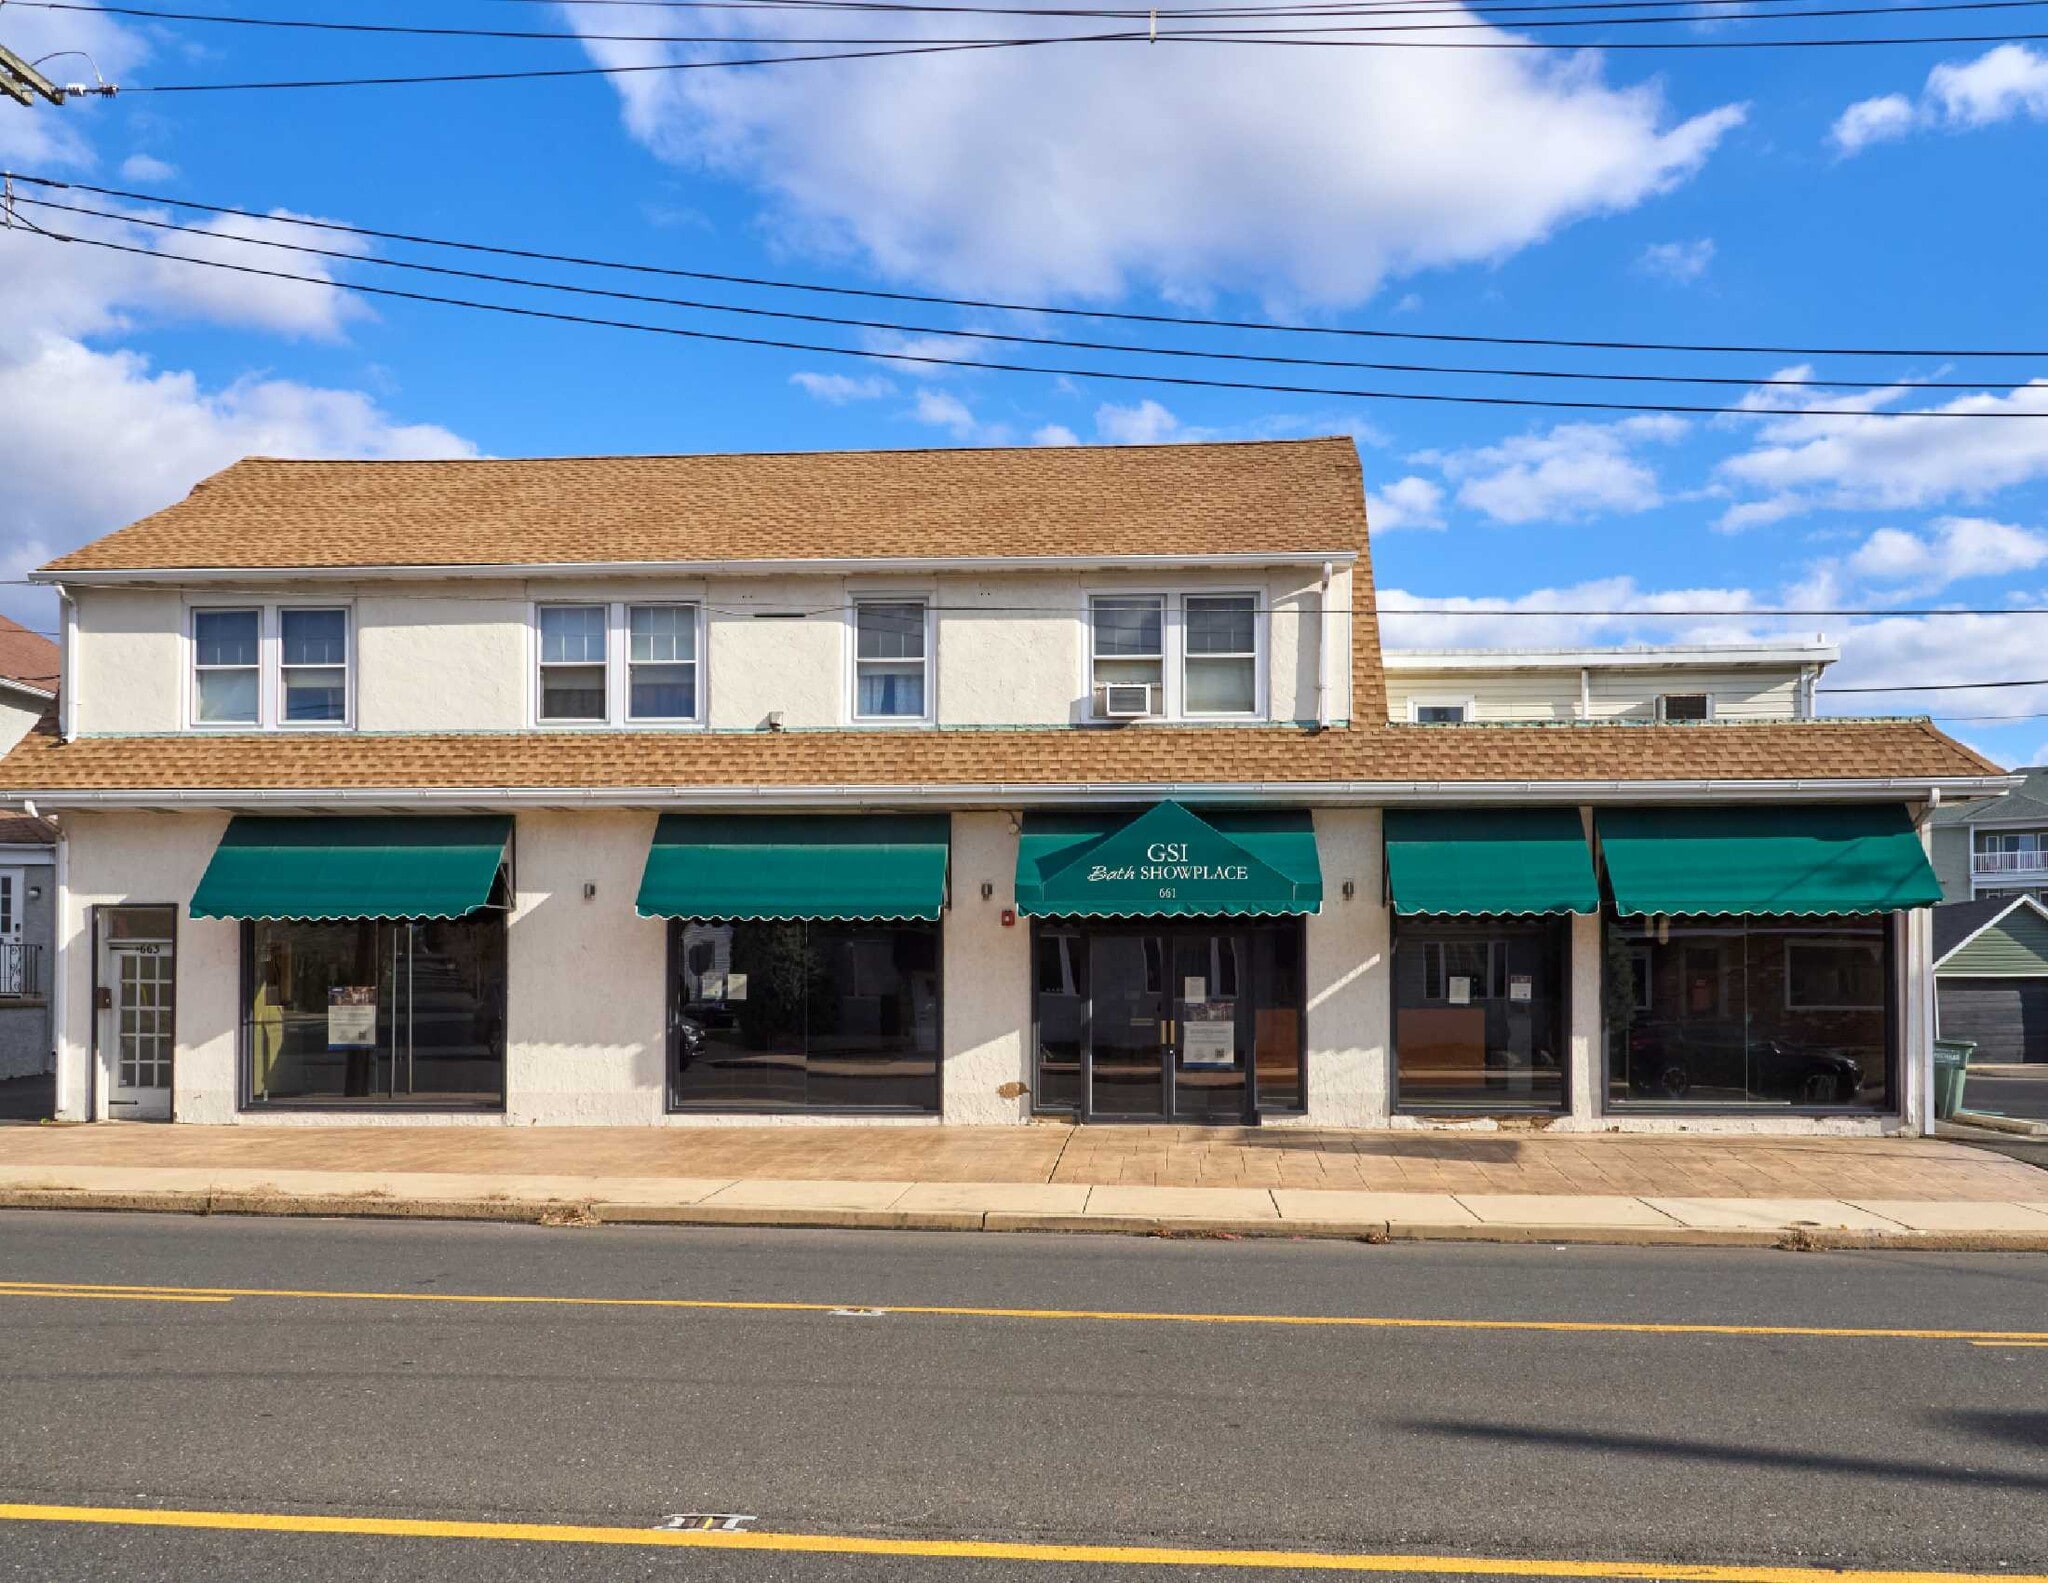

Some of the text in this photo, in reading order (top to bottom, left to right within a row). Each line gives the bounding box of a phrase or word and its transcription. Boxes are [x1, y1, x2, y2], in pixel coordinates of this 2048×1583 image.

[1147, 842, 1188, 862] GSI
[1087, 865, 1249, 882] Bath SHOWPLACE
[1159, 887, 1176, 898] 661
